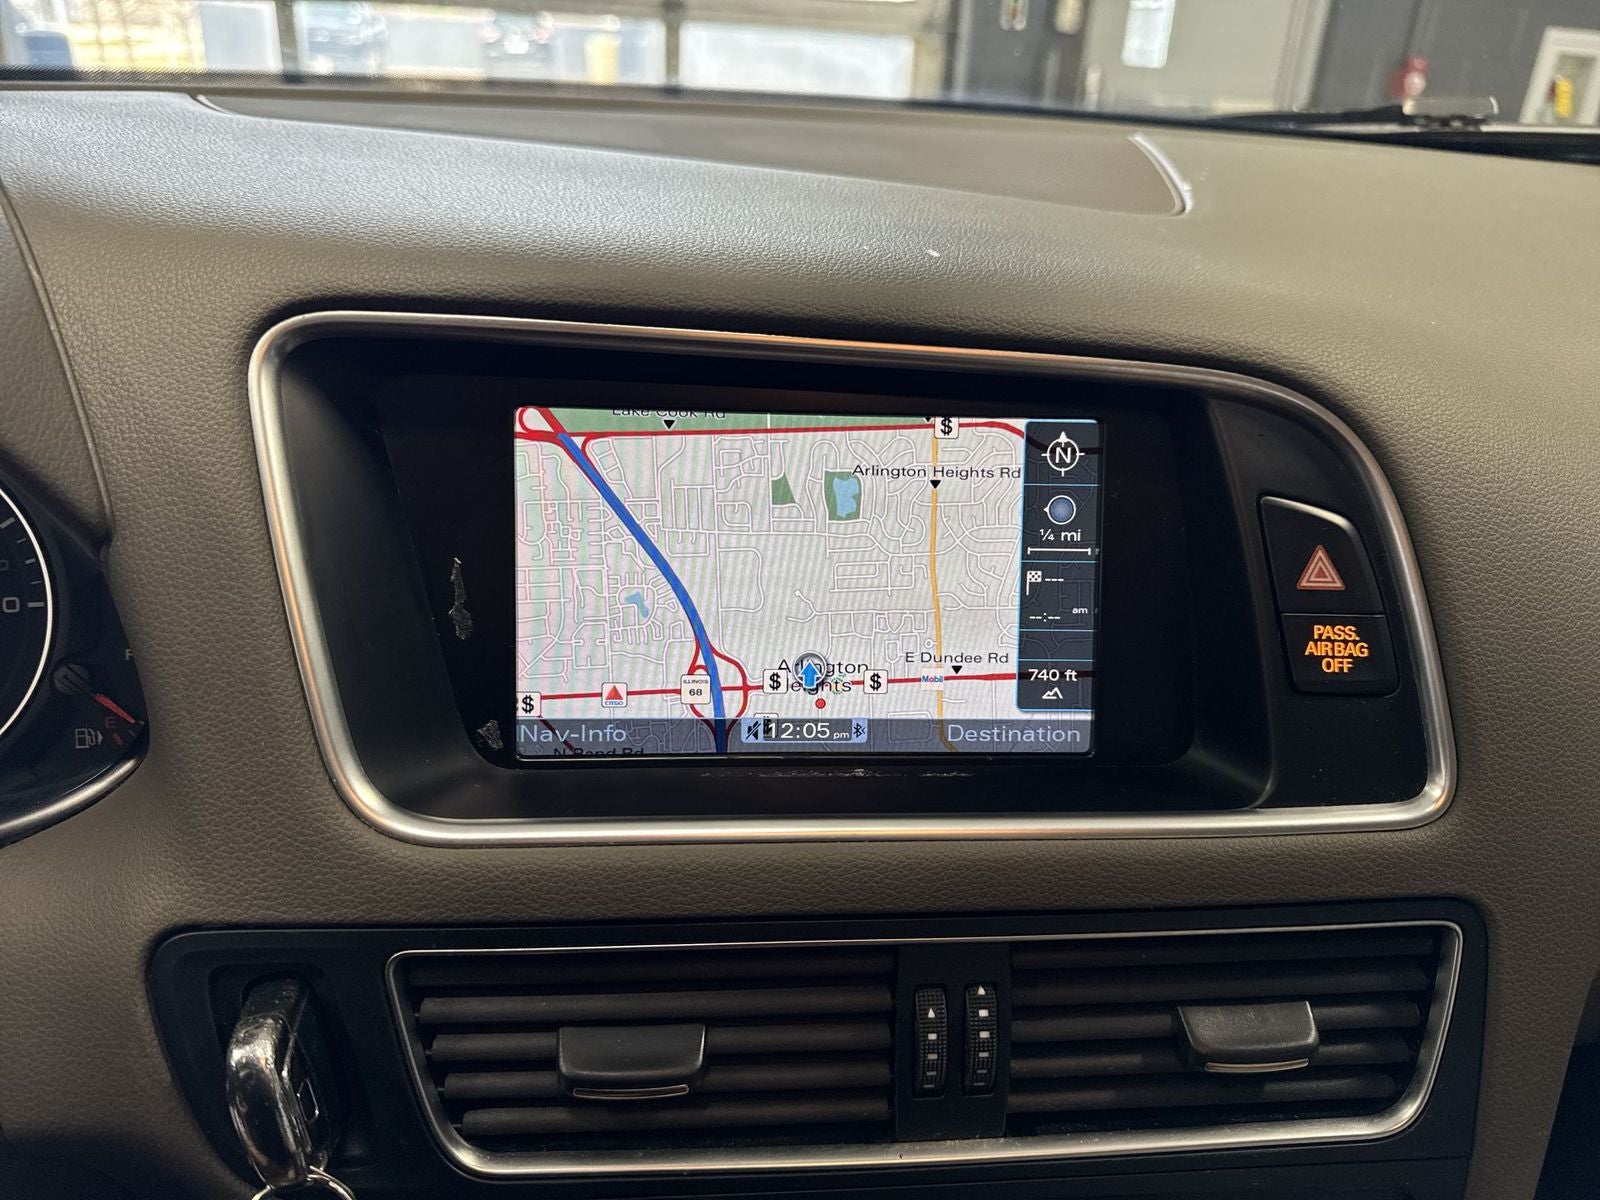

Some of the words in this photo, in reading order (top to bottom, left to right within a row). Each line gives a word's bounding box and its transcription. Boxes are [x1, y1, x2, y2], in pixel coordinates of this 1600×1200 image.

[1055, 447, 1072, 464] N
[852, 464, 927, 479] Arlington
[933, 466, 994, 479] Heights
[1000, 467, 1021, 479] Rd
[1061, 529, 1082, 541] mi
[1313, 625, 1360, 640] PASS.
[905, 652, 915, 663] E
[920, 652, 982, 664] Dundee
[988, 653, 1009, 664] Rd
[1321, 658, 1354, 673] OFF
[922, 675, 943, 683] Mobil
[1029, 669, 1060, 681] 740
[1064, 669, 1078, 681] ft
[520, 724, 627, 743] Nav-Info
[770, 723, 830, 739] 12:05
[834, 732, 850, 740] pm
[948, 724, 1081, 742] Destination
